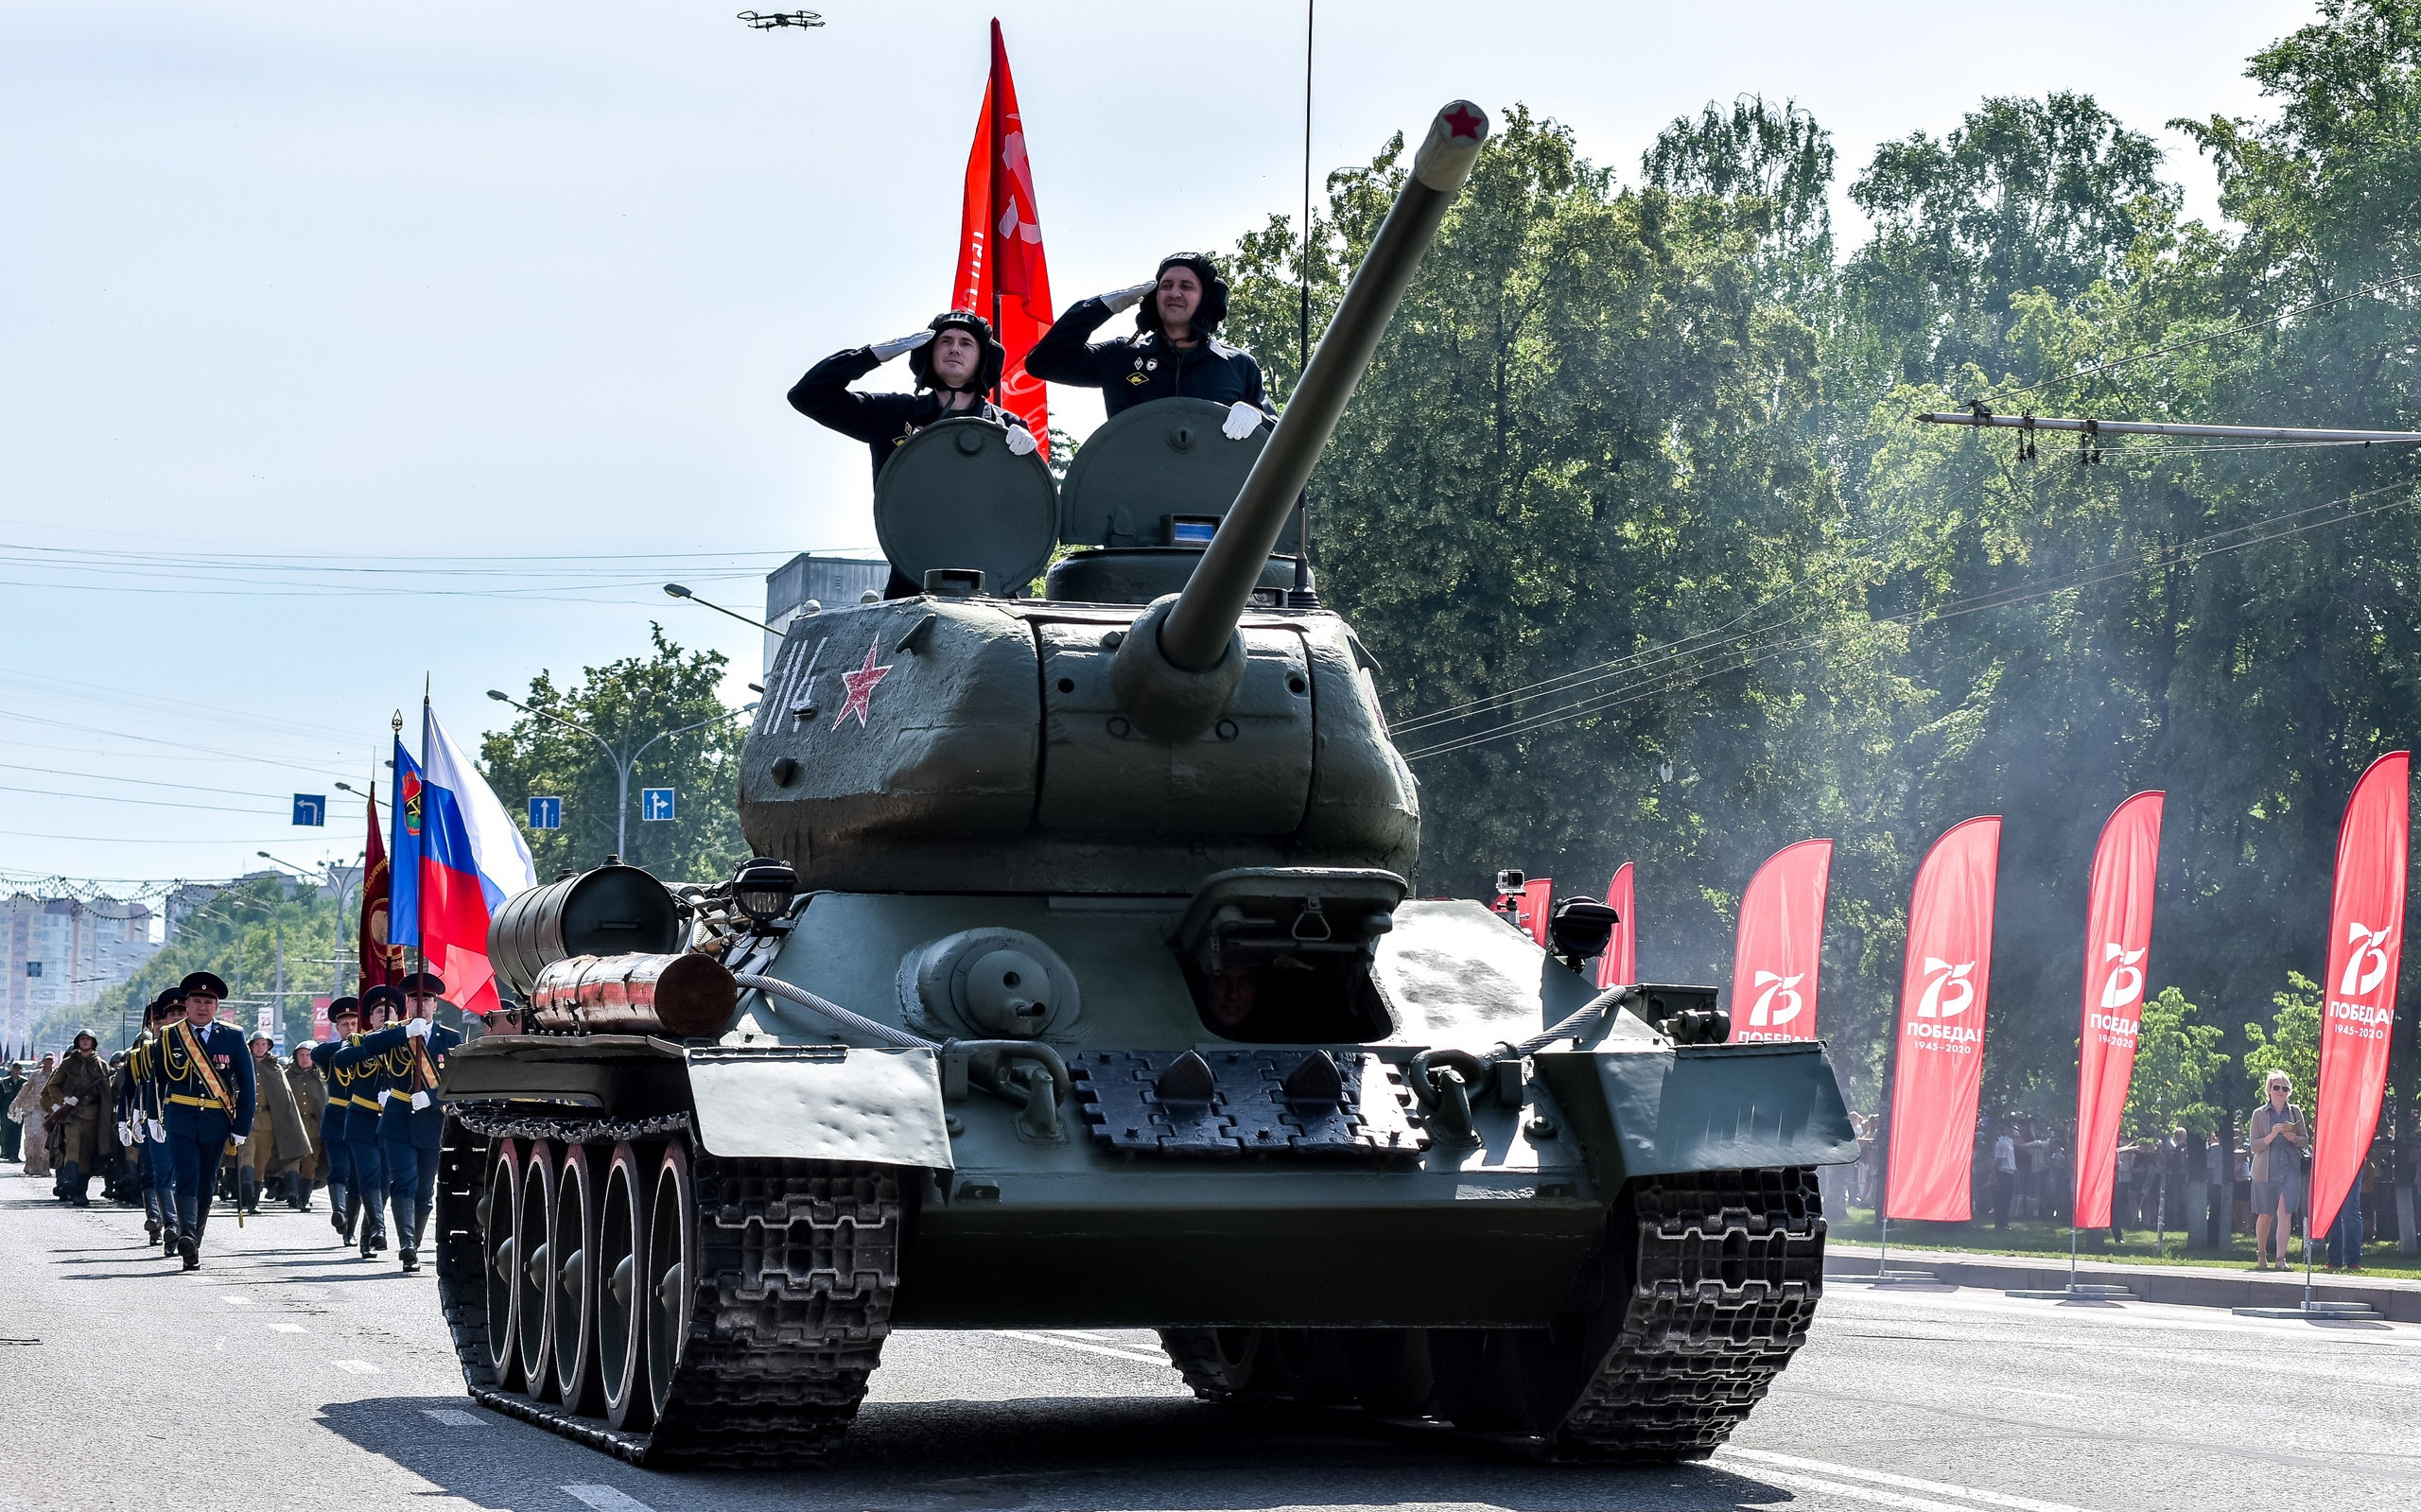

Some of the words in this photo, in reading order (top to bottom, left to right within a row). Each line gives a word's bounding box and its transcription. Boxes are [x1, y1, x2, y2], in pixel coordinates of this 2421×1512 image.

[763, 637, 828, 736] 114
[2340, 922, 2391, 996] 75
[1748, 970, 1805, 1027] 75
[1916, 956, 1976, 1018] 75
[1907, 1021, 1982, 1043] ПОБЕДА!
[2329, 1000, 2395, 1027] ПОБЕДА!
[2334, 1023, 2384, 1039] 1945-2020
[1913, 1040, 1971, 1054] 1945-2020
